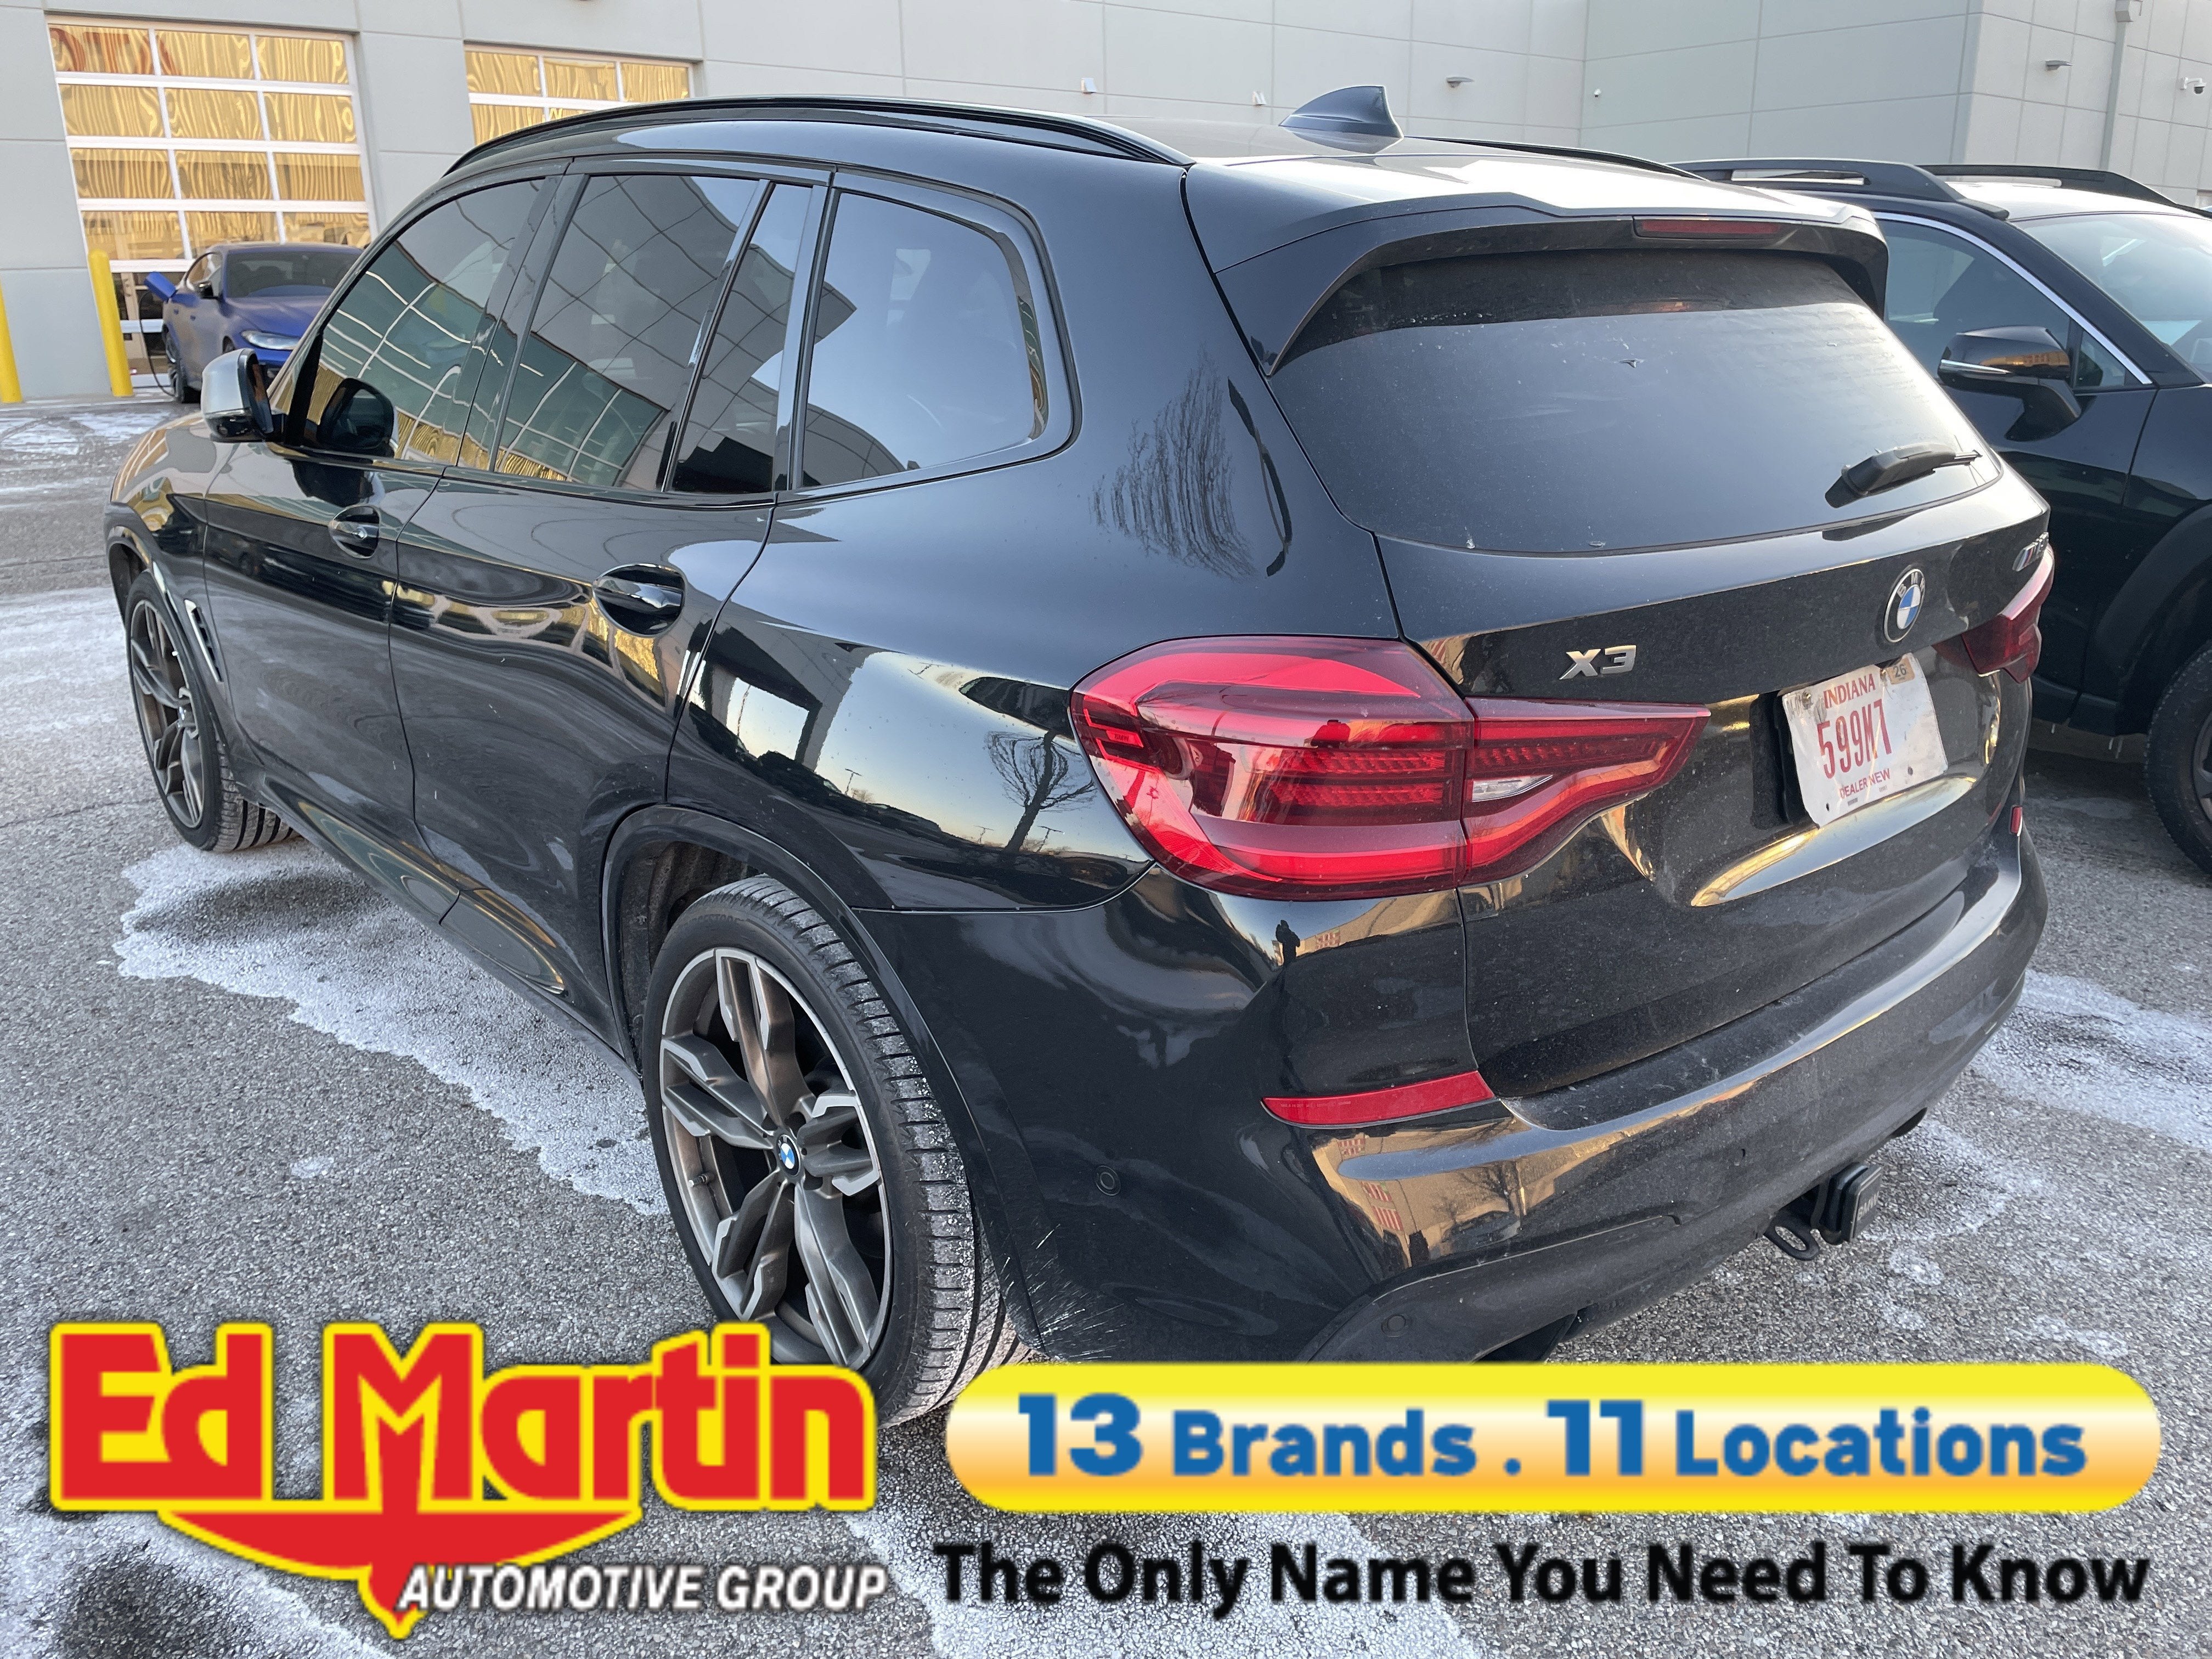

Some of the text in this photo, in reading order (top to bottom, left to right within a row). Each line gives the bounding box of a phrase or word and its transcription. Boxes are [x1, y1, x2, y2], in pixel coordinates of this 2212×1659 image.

[1559, 645, 1637, 680] X3
[1893, 664, 1907, 679] 26
[1823, 673, 1876, 709] INDIANA
[1817, 698, 1892, 779] 599M7
[1839, 768, 1891, 799] DEALER NEW
